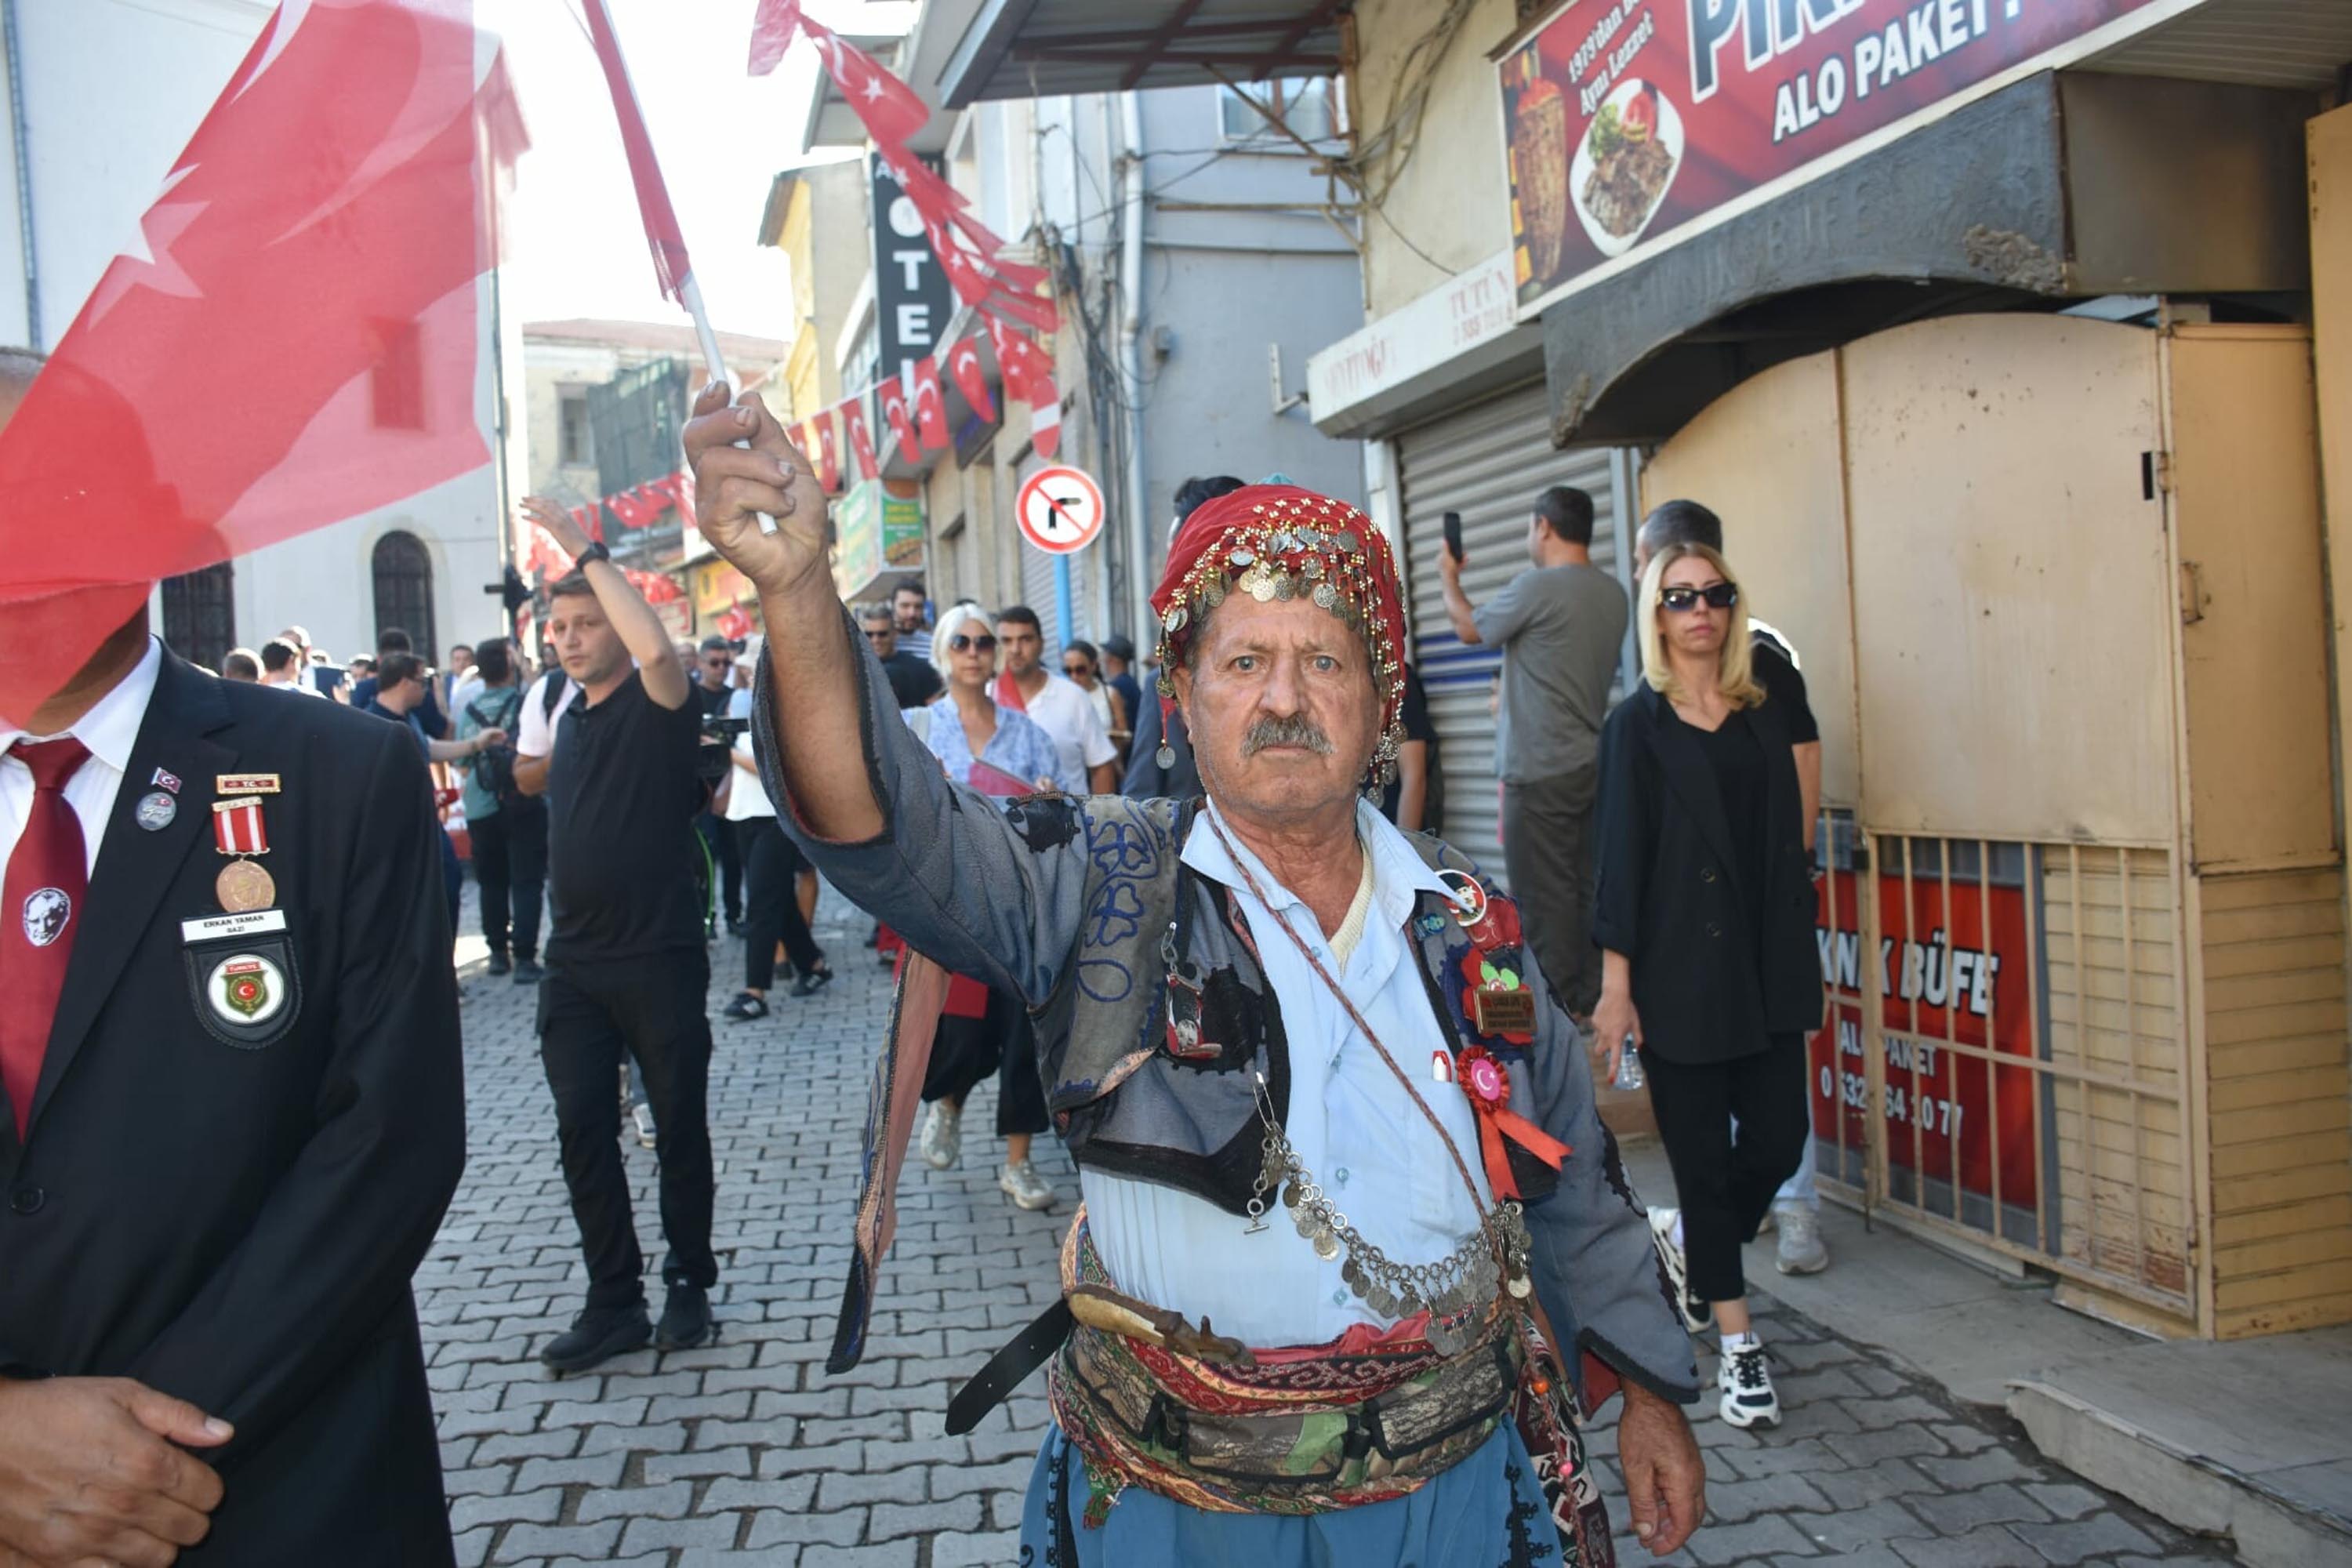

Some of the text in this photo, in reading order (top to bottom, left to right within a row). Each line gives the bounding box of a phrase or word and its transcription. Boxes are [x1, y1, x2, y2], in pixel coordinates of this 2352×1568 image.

[1773, 57, 1846, 143] ALO
[204, 915, 264, 928] ERKAN YAMAN
[1900, 930, 1999, 1015] BÜFE
[1841, 1021, 1864, 1057] AL
[1820, 1065, 1832, 1098] 0
